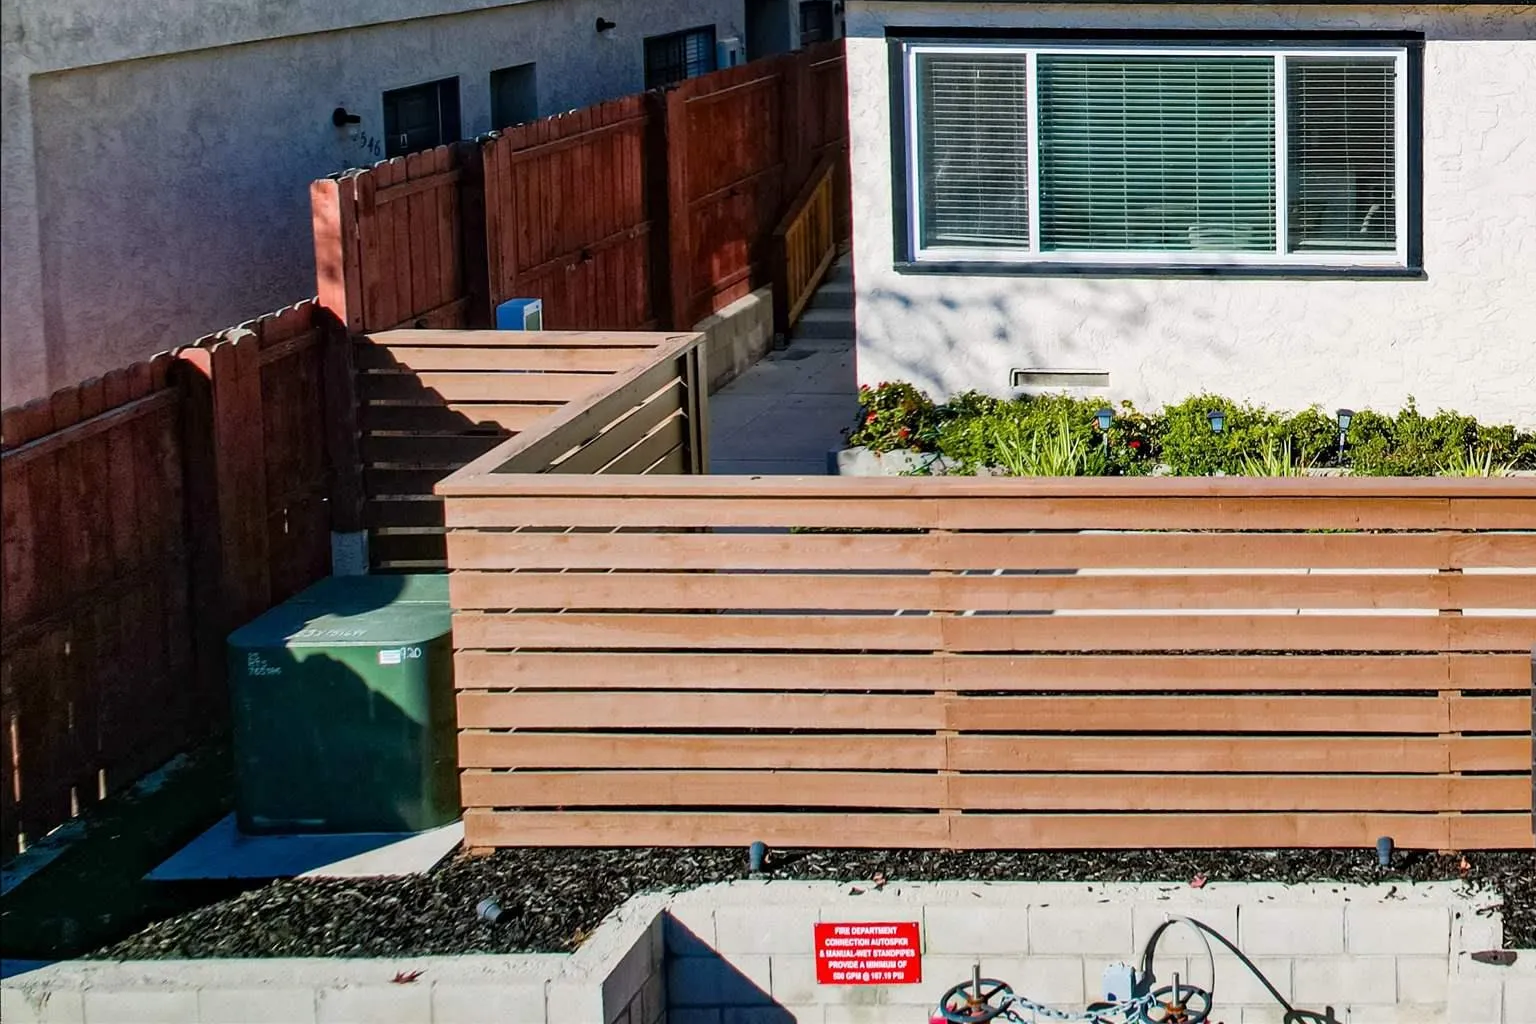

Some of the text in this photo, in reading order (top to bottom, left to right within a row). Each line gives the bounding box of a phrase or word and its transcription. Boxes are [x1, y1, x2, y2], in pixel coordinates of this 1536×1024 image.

[834, 927, 850, 935] FIRE
[825, 938, 870, 946] CONNECTION
[828, 960, 858, 969] PROVIDE
[897, 959, 907, 968] OF
